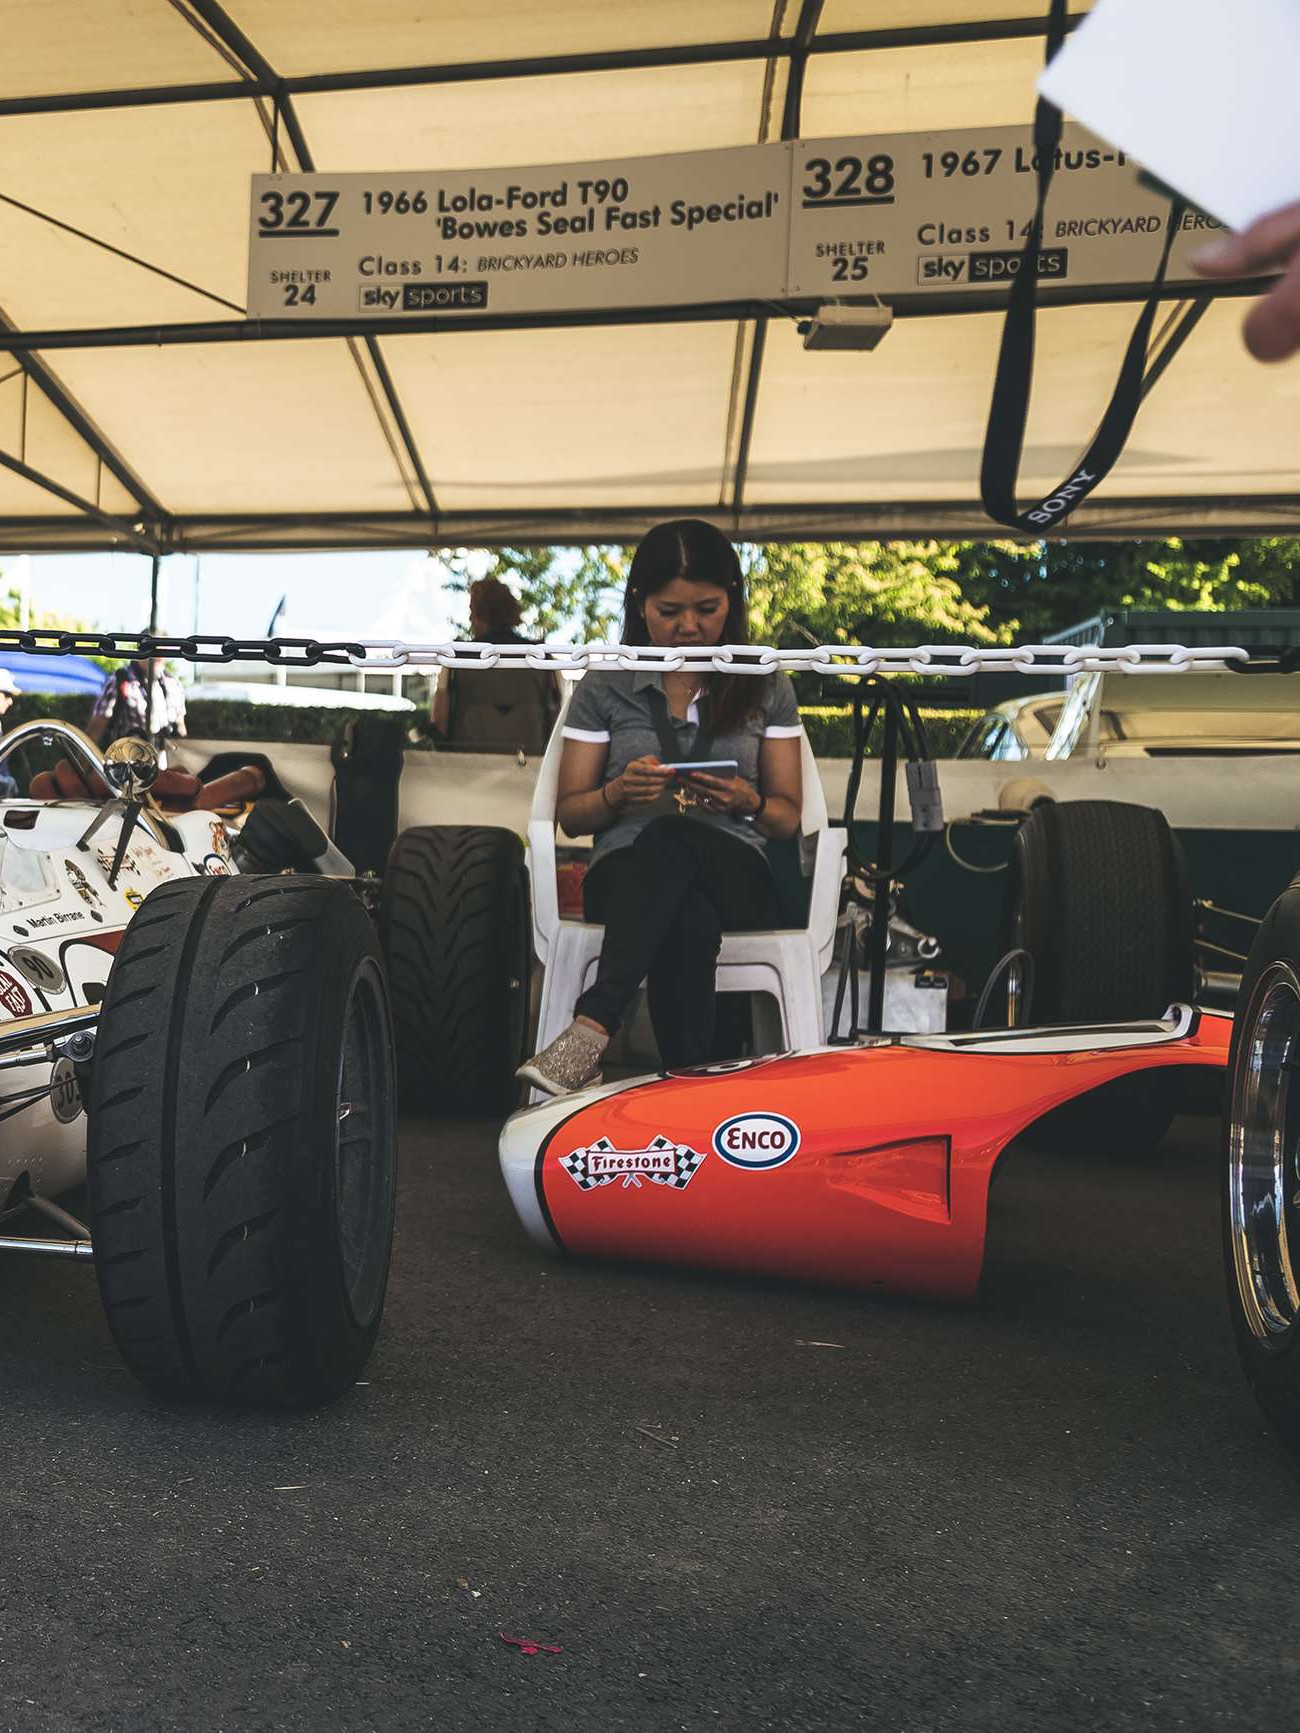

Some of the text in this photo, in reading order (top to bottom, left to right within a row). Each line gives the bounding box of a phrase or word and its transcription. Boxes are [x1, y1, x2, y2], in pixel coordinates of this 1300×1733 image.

[802, 154, 894, 198] 328
[921, 148, 1003, 178] 1967
[258, 190, 340, 230] 327
[362, 178, 629, 216] 1966 Lola-Ford T90
[436, 190, 779, 241] 'Bowes Seal Fast Special'
[916, 222, 990, 246] Class
[1055, 215, 1162, 238] BRICKYARD
[358, 246, 639, 276] Class 14: BRICKYARD HEROES
[815, 240, 886, 258] SHELTER
[269, 268, 332, 284] SHELTER
[831, 257, 869, 281] 25
[923, 253, 1061, 281] sky spots
[284, 284, 317, 307] 24
[363, 284, 483, 310] sky sports
[1027, 469, 1096, 524] SONY
[26, 910, 86, 929] Martin Birrane
[20, 954, 55, 980] 90
[726, 1127, 786, 1152] ENCO
[590, 1153, 672, 1172] Firestone
